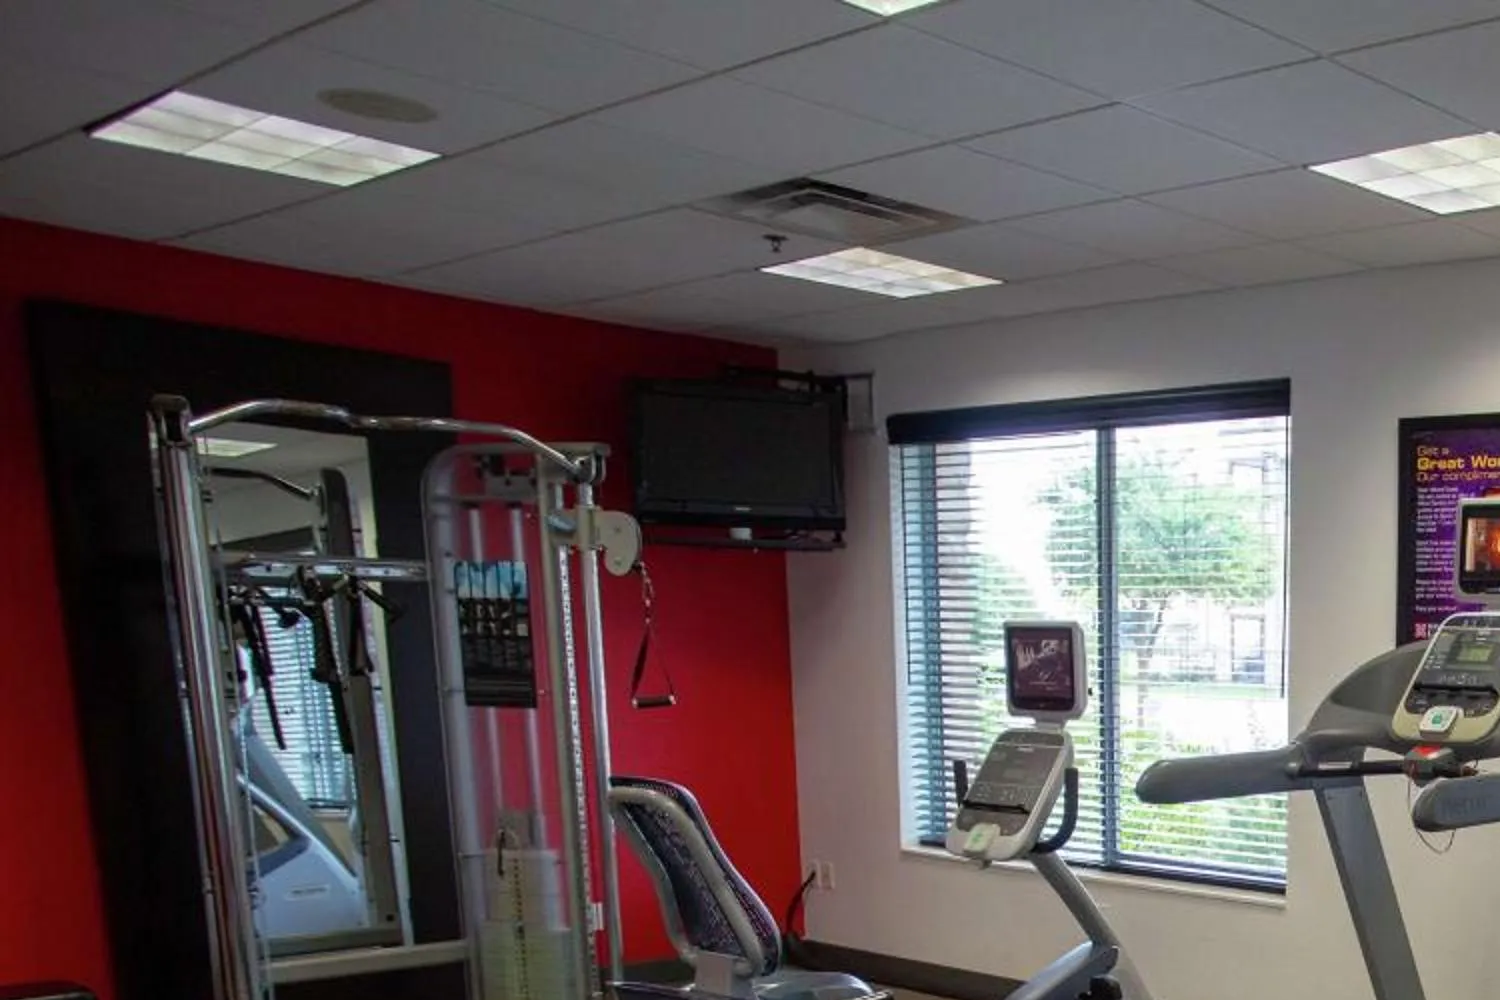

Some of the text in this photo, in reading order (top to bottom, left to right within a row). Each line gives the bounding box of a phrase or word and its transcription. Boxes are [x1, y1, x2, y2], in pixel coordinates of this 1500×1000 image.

[1417, 446, 1439, 456] Get
[1417, 457, 1464, 470] Great
[1417, 471, 1440, 482] Our
